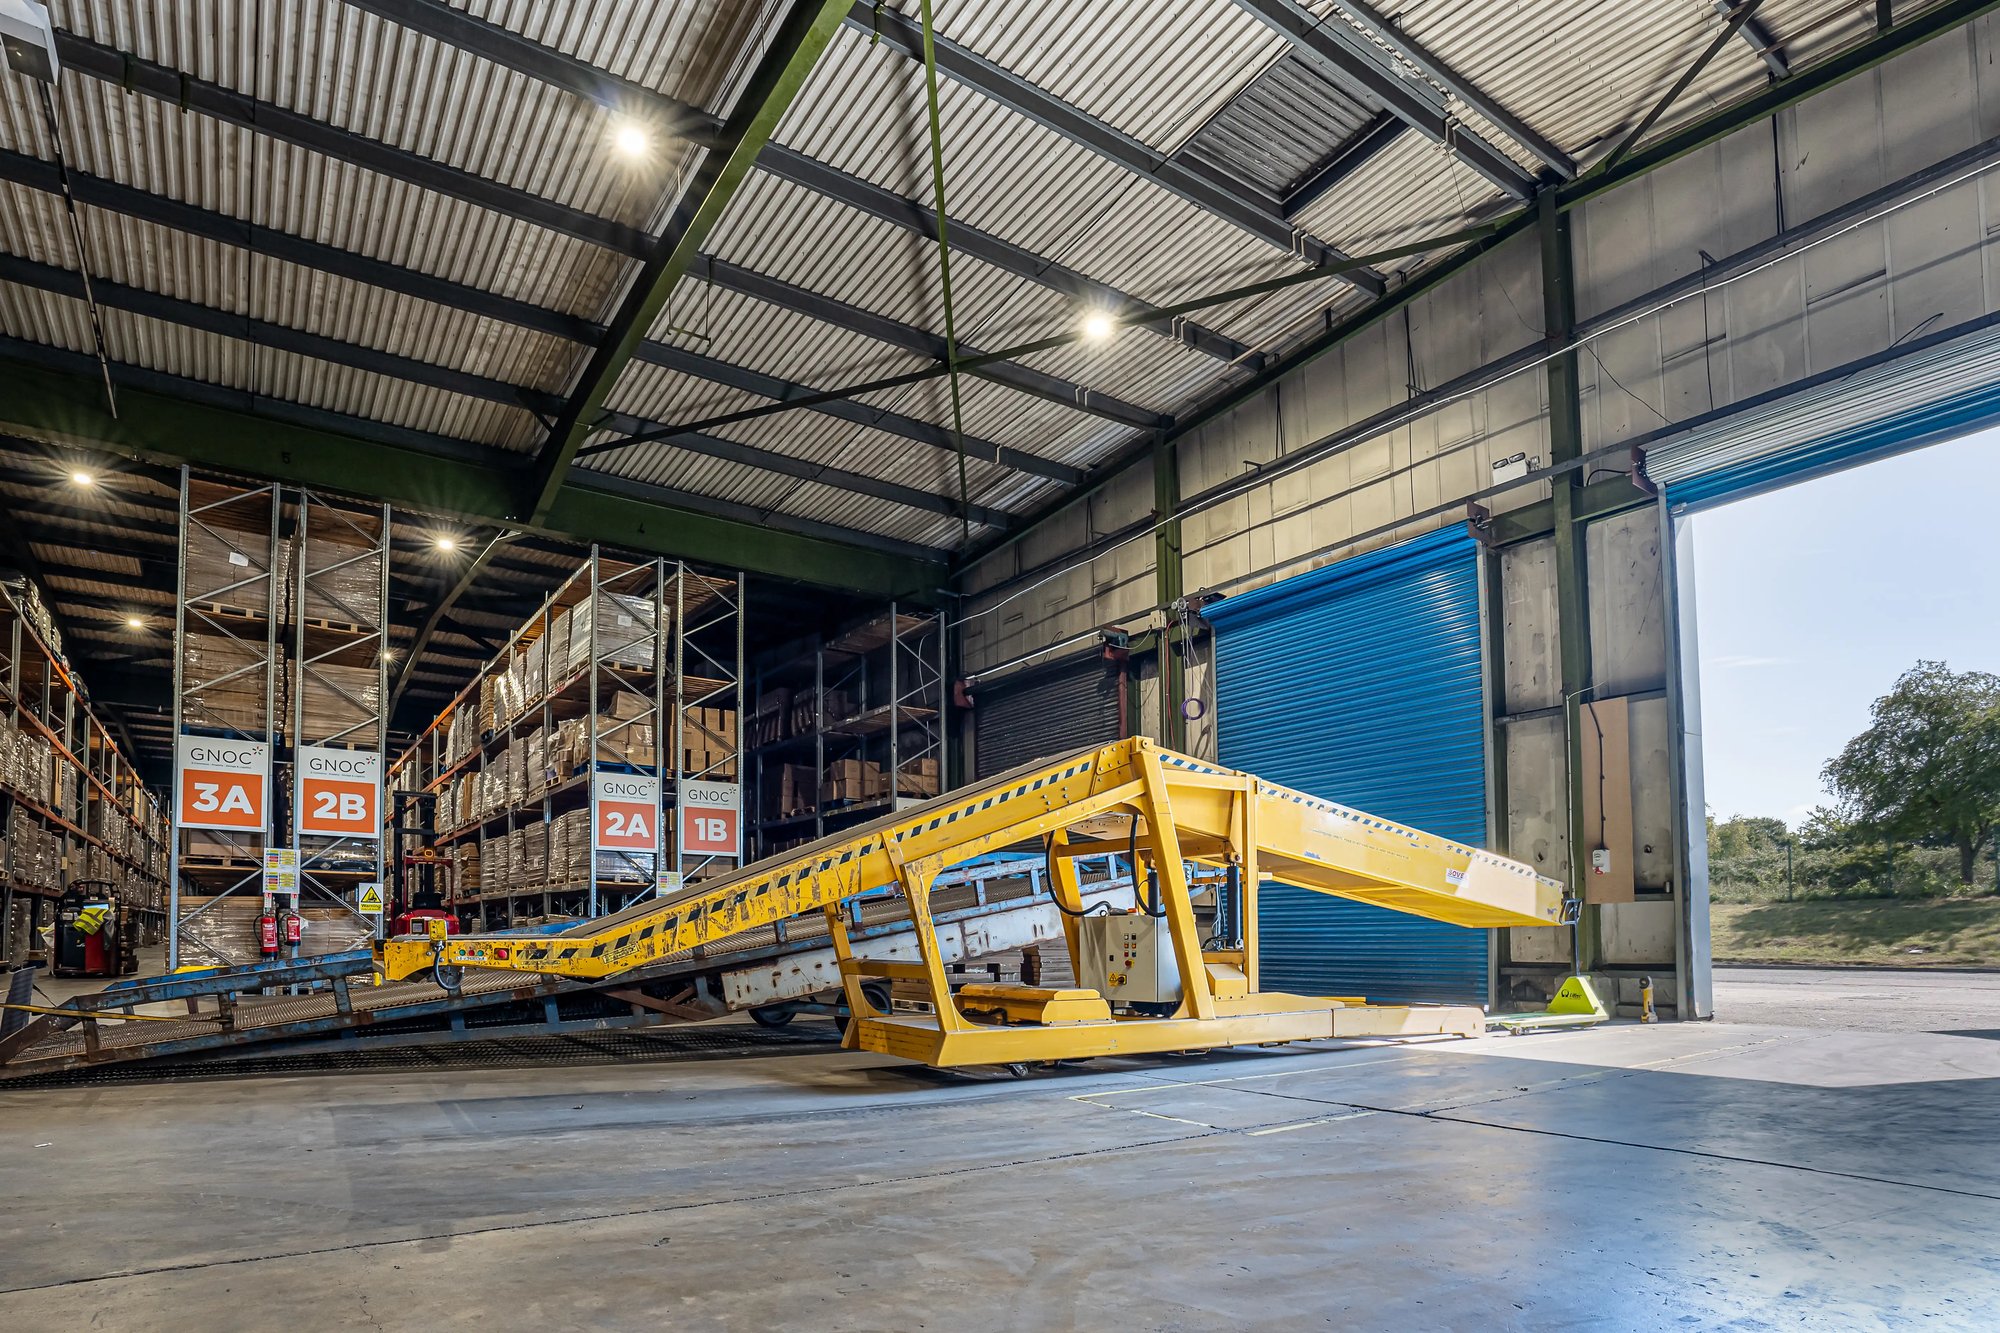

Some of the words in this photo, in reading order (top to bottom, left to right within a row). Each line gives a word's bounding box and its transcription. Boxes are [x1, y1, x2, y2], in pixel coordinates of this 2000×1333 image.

[191, 748, 252, 765] GNOC
[310, 758, 366, 774] GNOC
[192, 782, 255, 815] 3A
[604, 782, 648, 796] GNOC
[688, 789, 729, 803] GNOC
[313, 791, 367, 821] 2B
[605, 811, 651, 838] 2A
[694, 817, 728, 842] 1B
